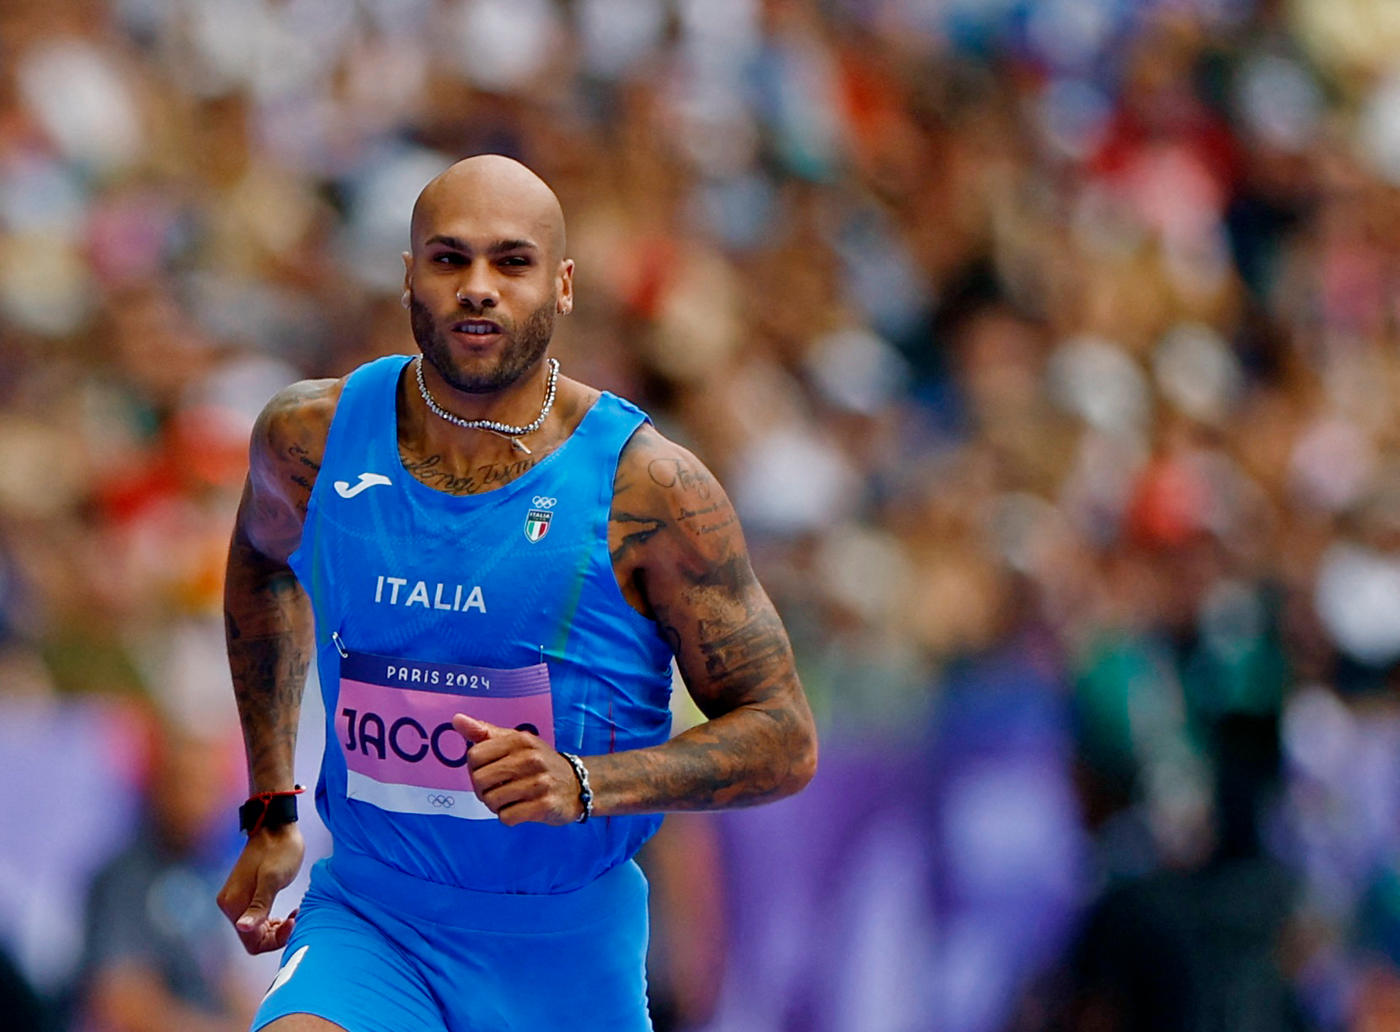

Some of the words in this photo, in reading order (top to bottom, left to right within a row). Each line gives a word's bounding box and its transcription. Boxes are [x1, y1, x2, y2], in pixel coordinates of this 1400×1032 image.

[374, 575, 487, 614] ITALIA
[445, 672, 490, 690] 2024
[342, 708, 539, 768] JACO
